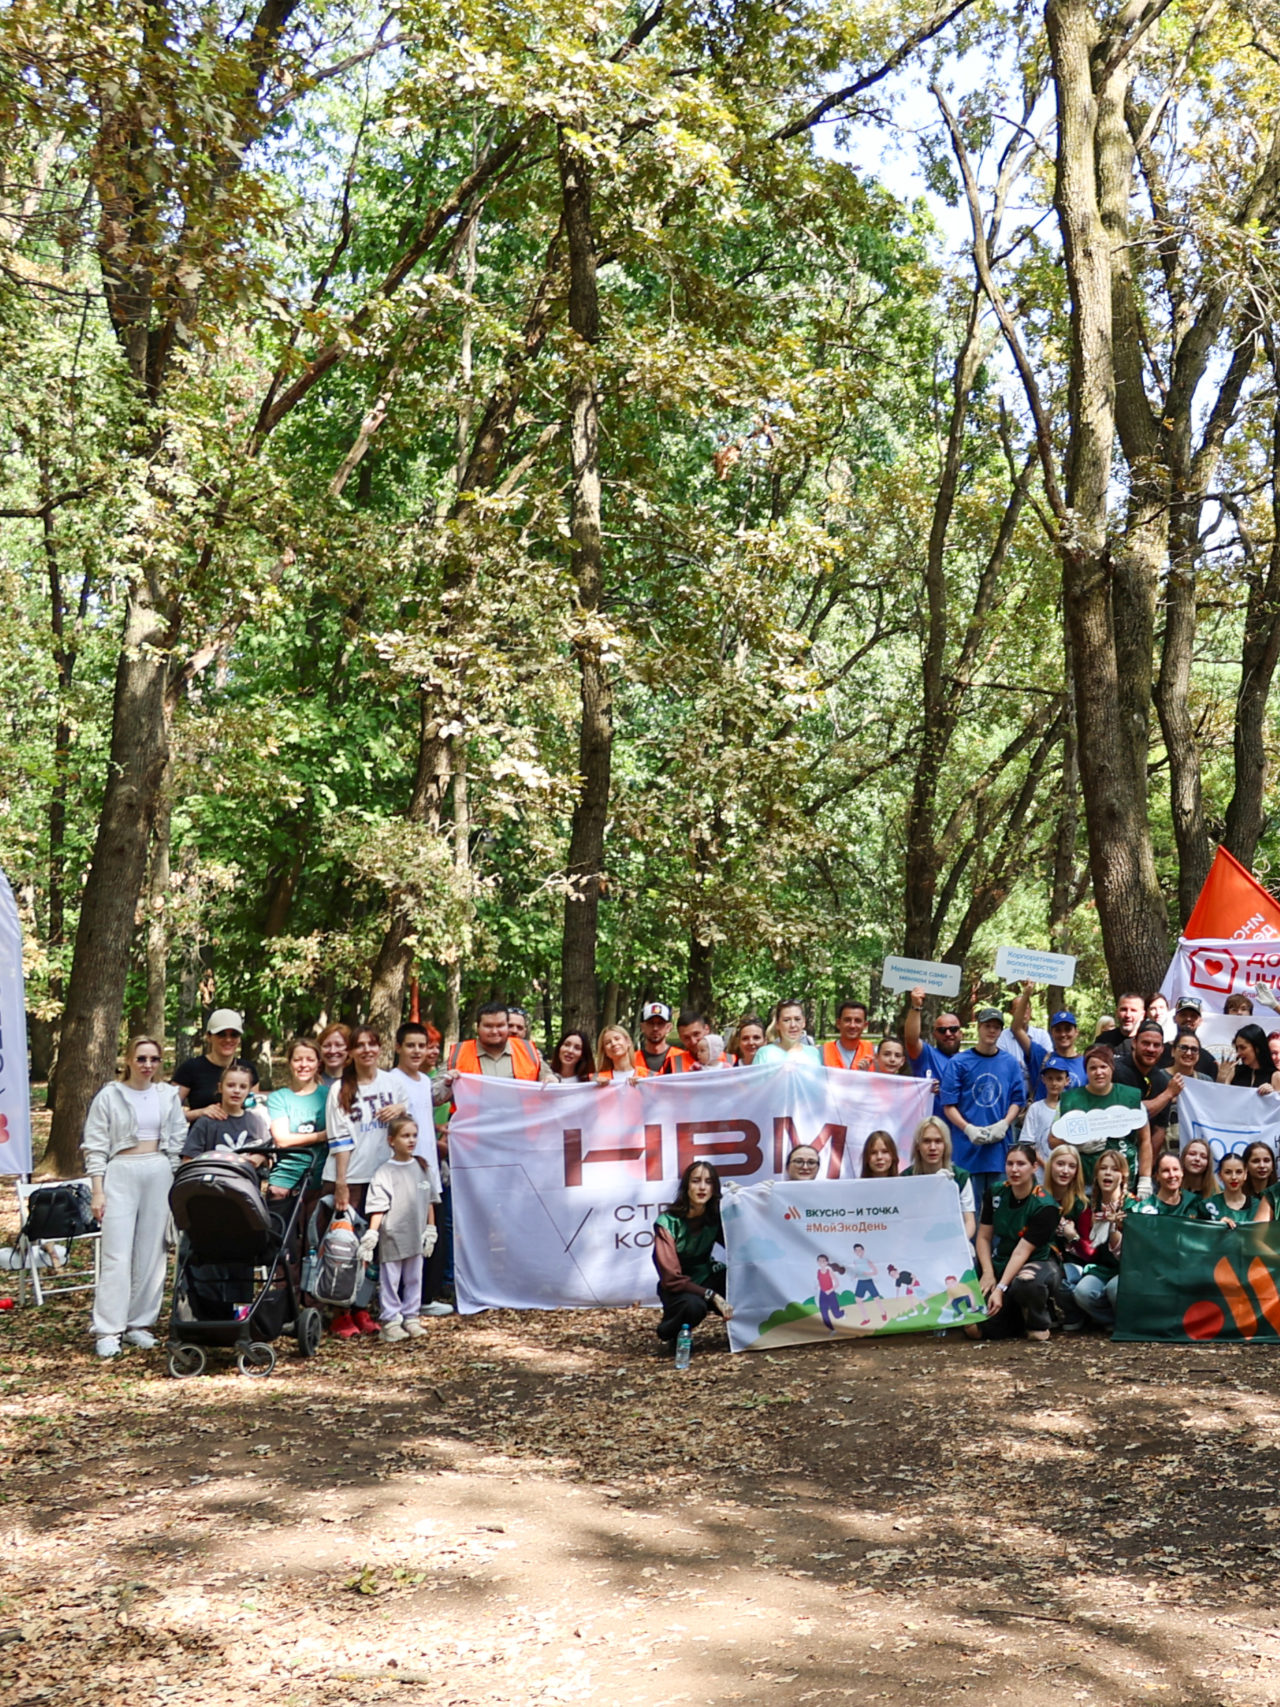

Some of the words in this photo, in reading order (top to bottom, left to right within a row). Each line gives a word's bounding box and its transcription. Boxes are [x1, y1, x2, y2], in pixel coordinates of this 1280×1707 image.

[563, 1116, 848, 1187] НВМ
[805, 1208, 846, 1218] ВКУСНО
[856, 1208, 864, 1216] И
[866, 1206, 900, 1216] ТОЧКА
[806, 1221, 888, 1233] #МойЭкоДень
